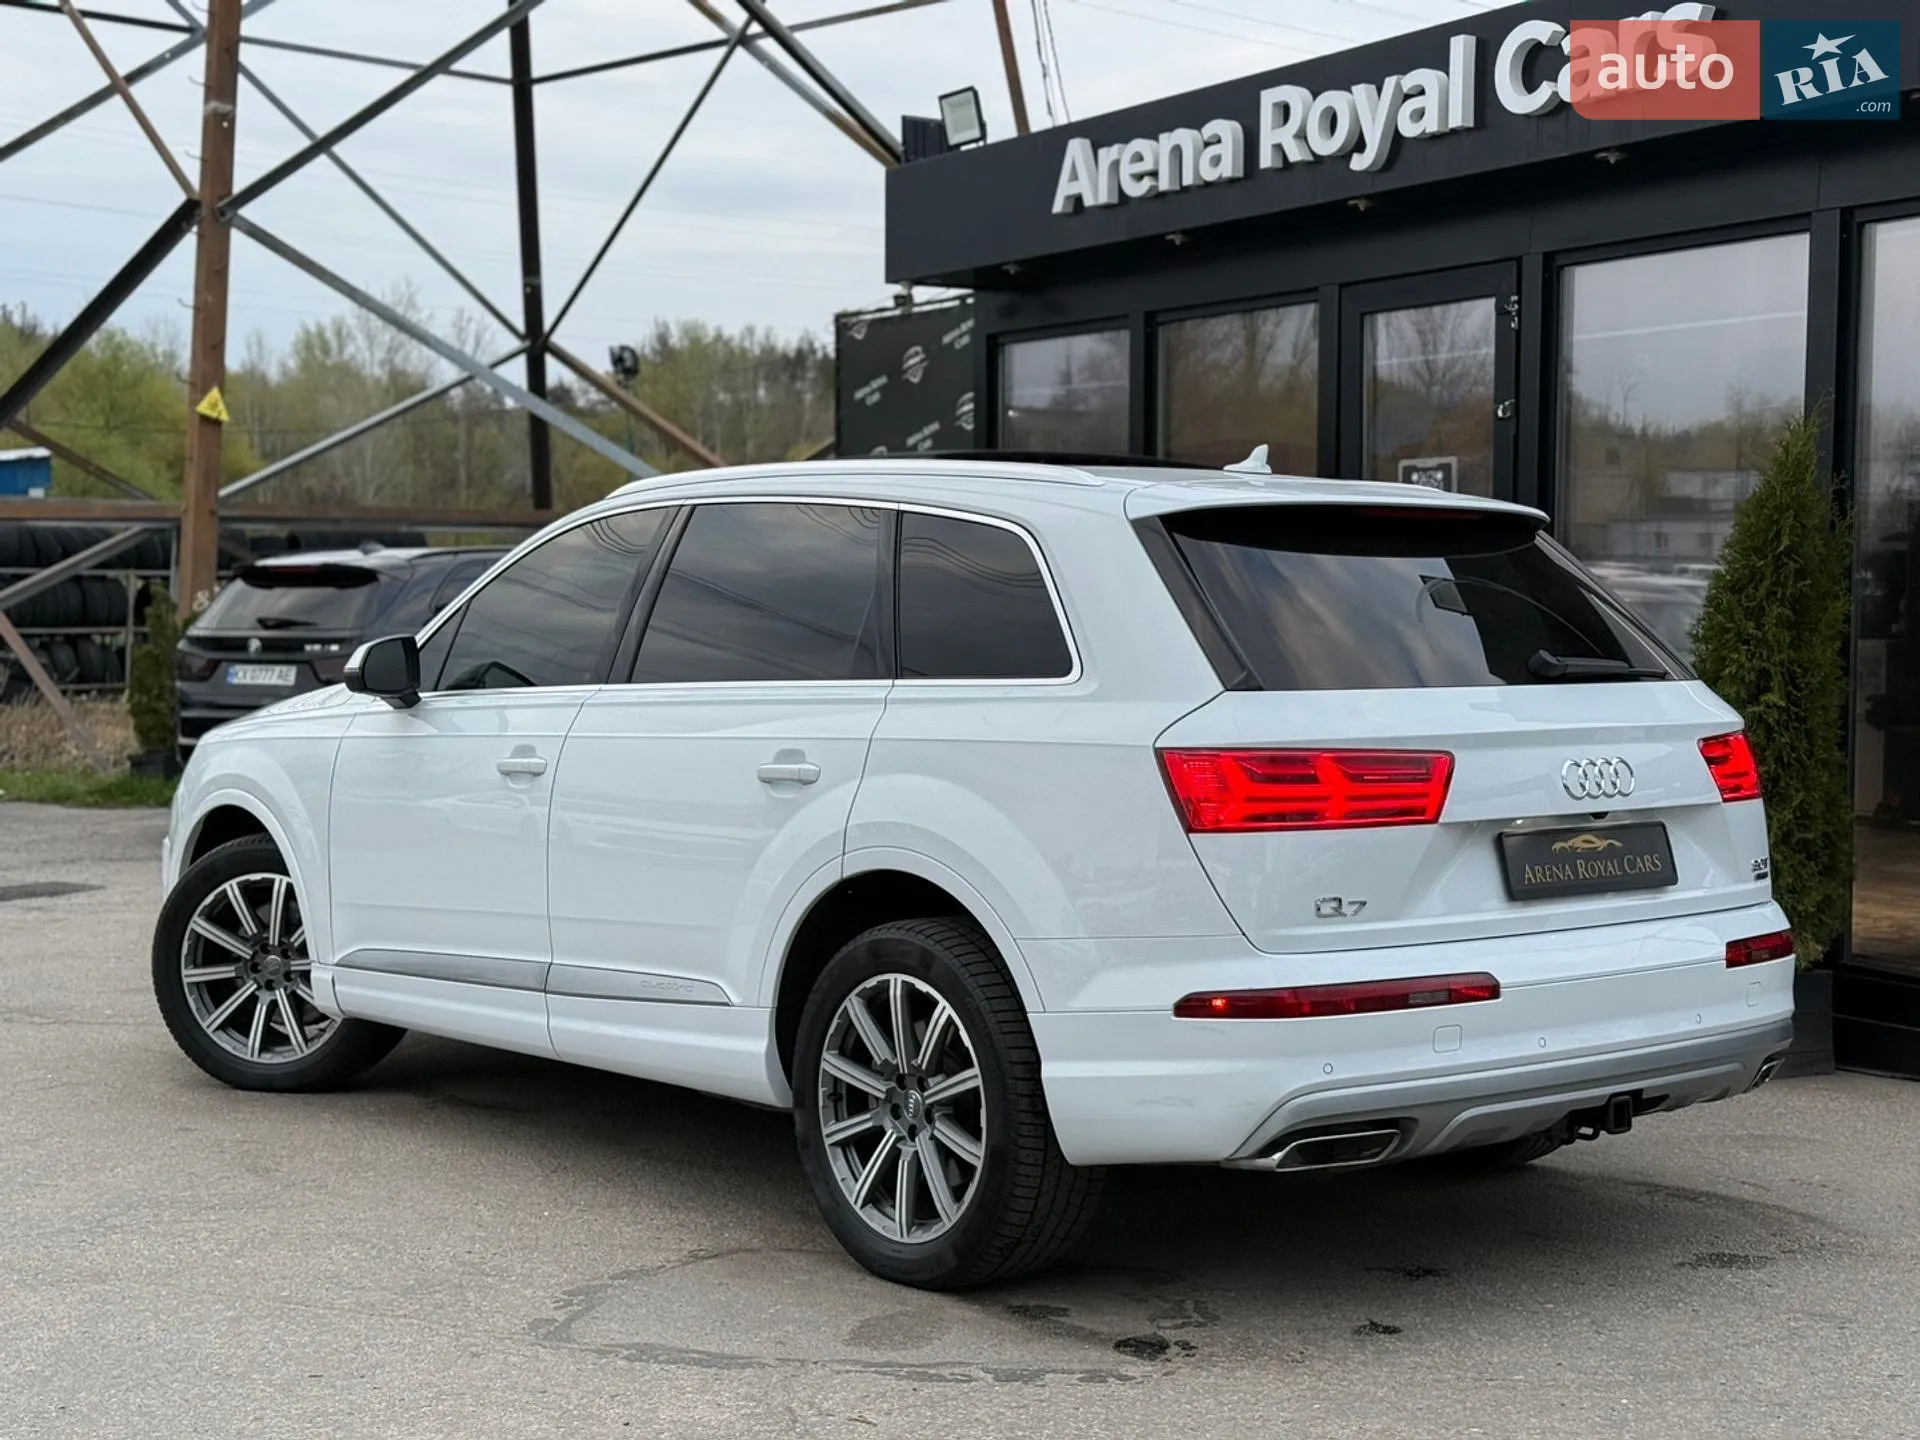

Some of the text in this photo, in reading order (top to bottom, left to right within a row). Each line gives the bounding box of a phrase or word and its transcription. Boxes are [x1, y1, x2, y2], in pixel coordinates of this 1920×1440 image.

[1052, 2, 1718, 214] Arena Royal Cars
[1524, 854, 1663, 885] ARENA ROYAL CARS
[1314, 896, 1368, 918] Q7
